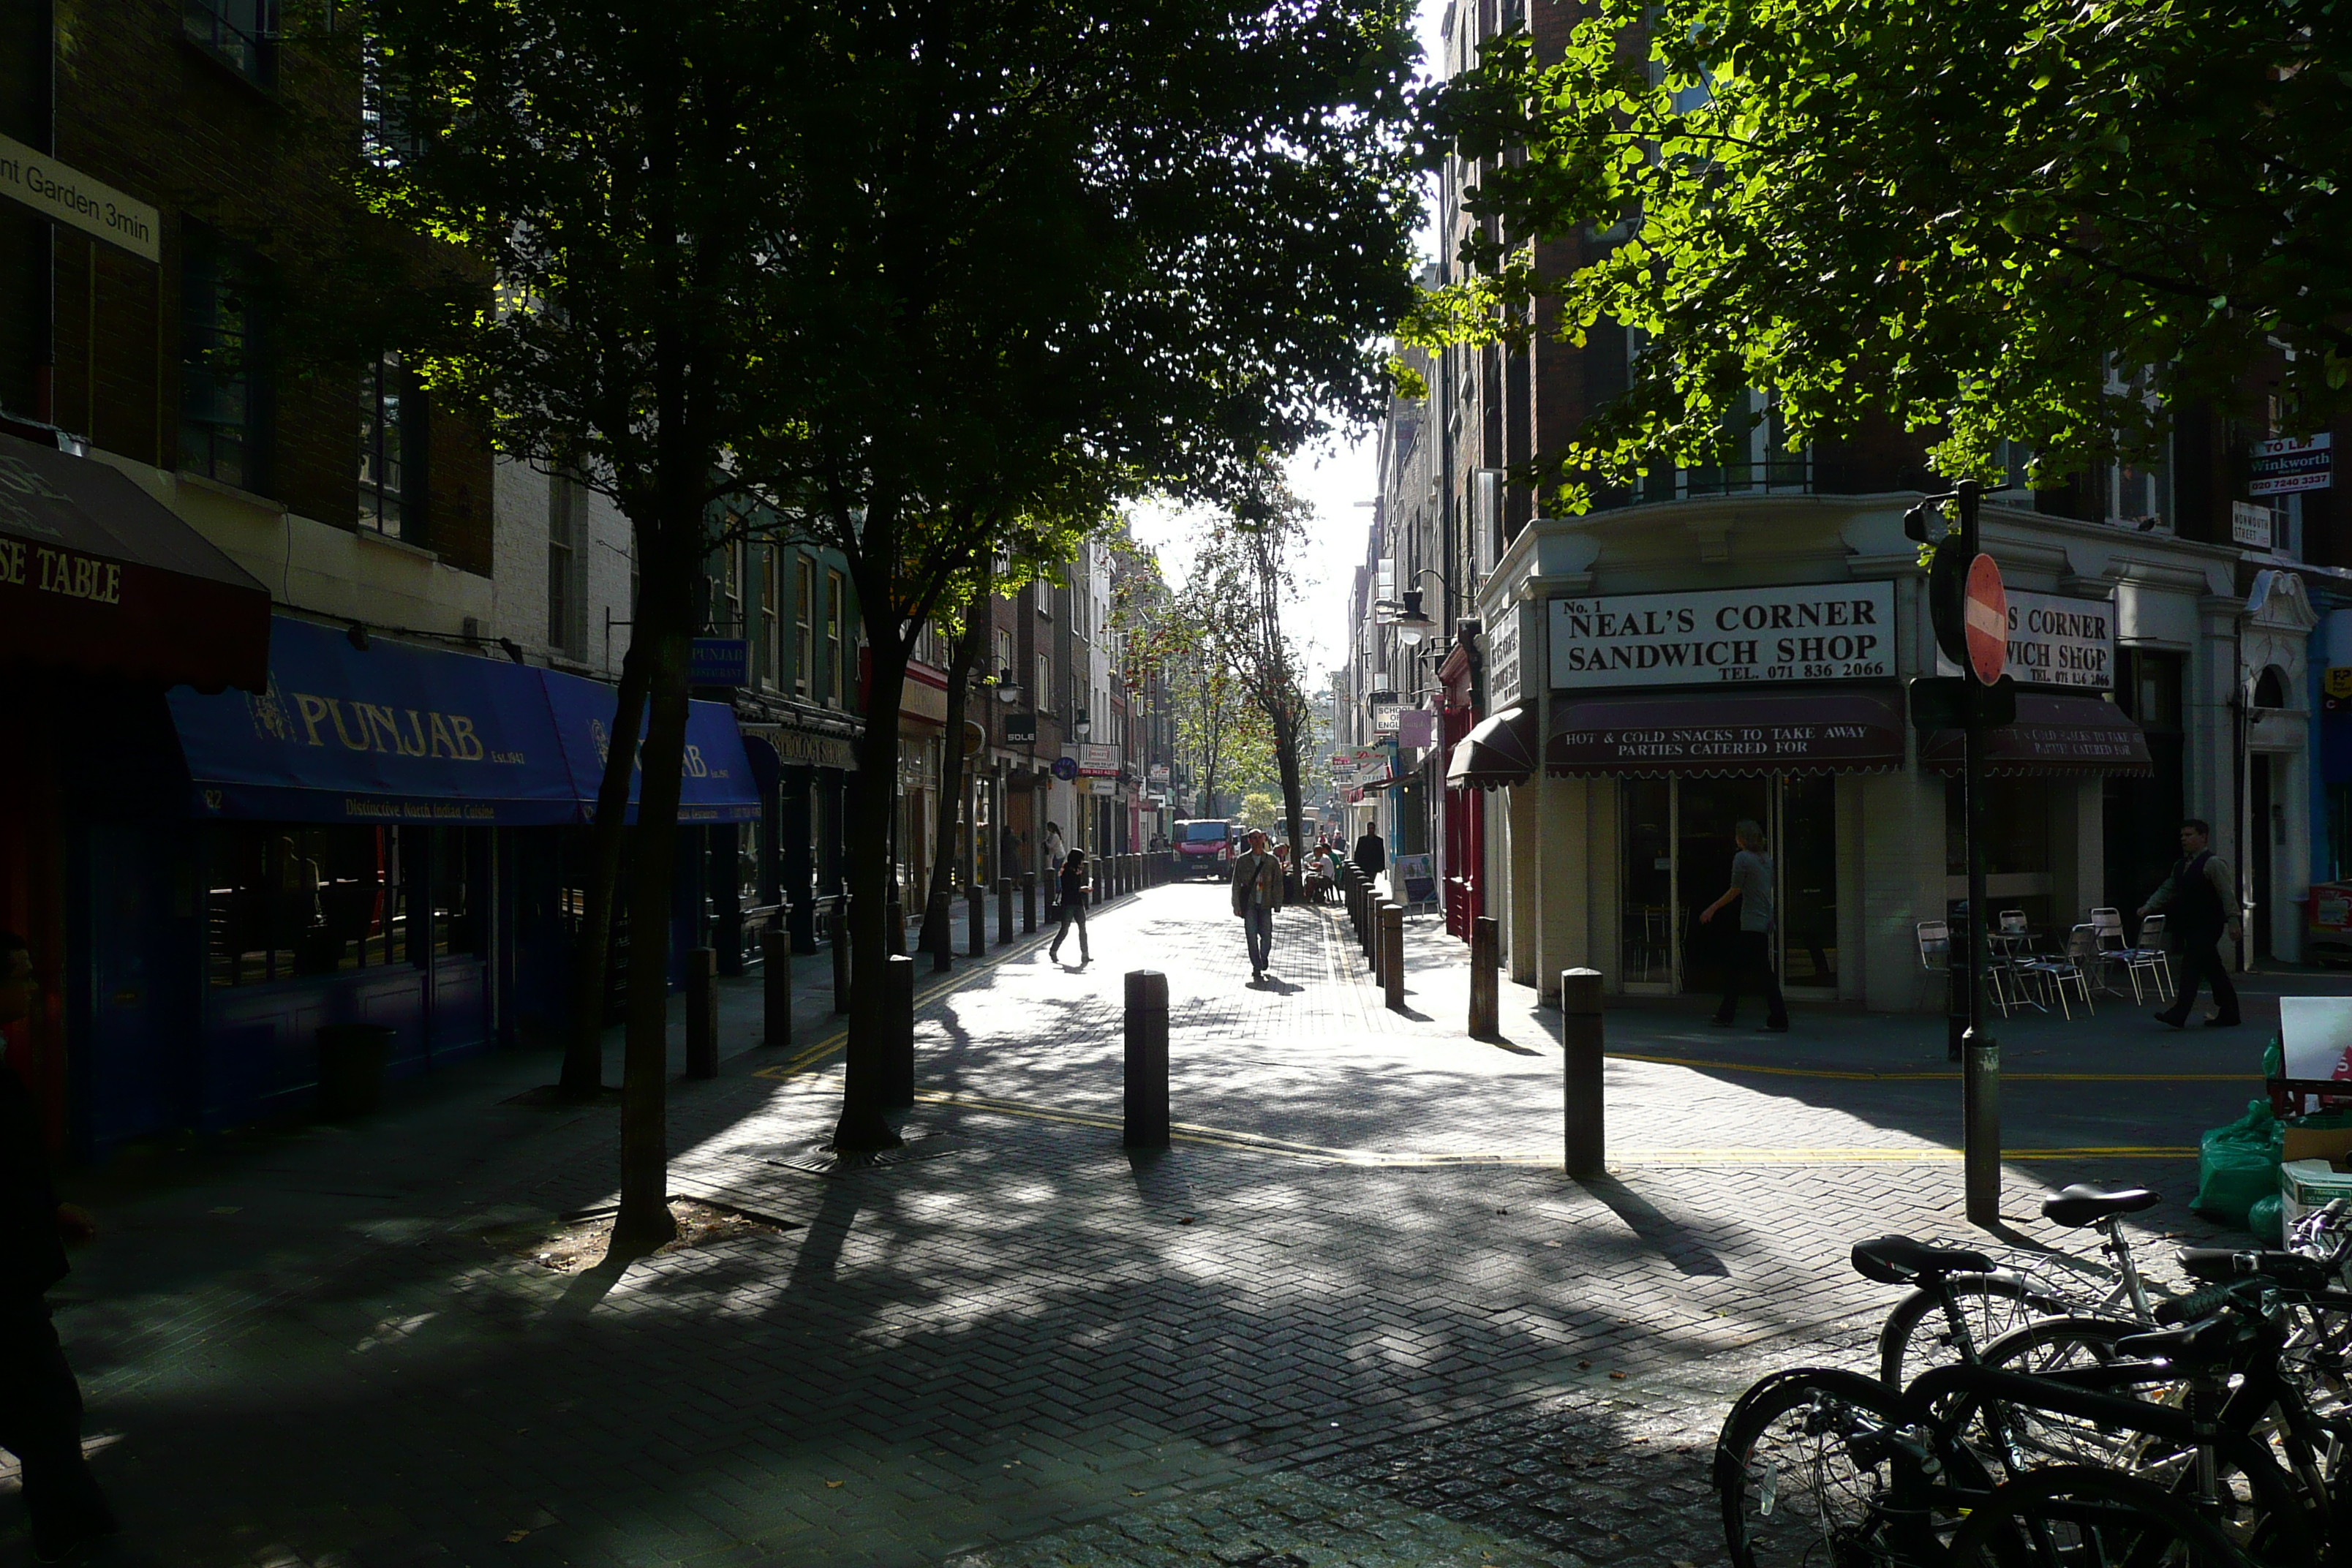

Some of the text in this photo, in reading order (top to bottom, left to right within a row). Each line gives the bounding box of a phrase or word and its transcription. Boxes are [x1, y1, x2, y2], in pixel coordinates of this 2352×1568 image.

[26, 166, 99, 220] Garden
[105, 203, 149, 243] 3min
[2266, 442, 2283, 453] TO
[2252, 452, 2330, 473] Winkworth
[2252, 481, 2271, 490] 020
[2274, 478, 2299, 488] 7240
[2302, 475, 2326, 484] 3337
[2234, 513, 2269, 529] MONMOUTH
[2234, 527, 2256, 541] STREET
[37, 546, 121, 605] TABLE
[1564, 600, 1602, 614] No. 1
[1569, 600, 1877, 638] NEAL'S CORNER
[2028, 608, 2106, 640] CORNER
[692, 648, 743, 661] PUNJAB
[1569, 635, 1877, 671] SANDWICH SHOP
[1719, 662, 1884, 680] TEL. 071 836 2066
[291, 692, 484, 761] PUNJAB
[1566, 726, 1867, 745] HOT & COLD SNACKS TO TAKE AWAY
[1007, 733, 1036, 741] SOLE
[1618, 741, 1808, 755] PARTIES CATERED FOR
[345, 798, 495, 819] Distinctive North Indian Cuisine
